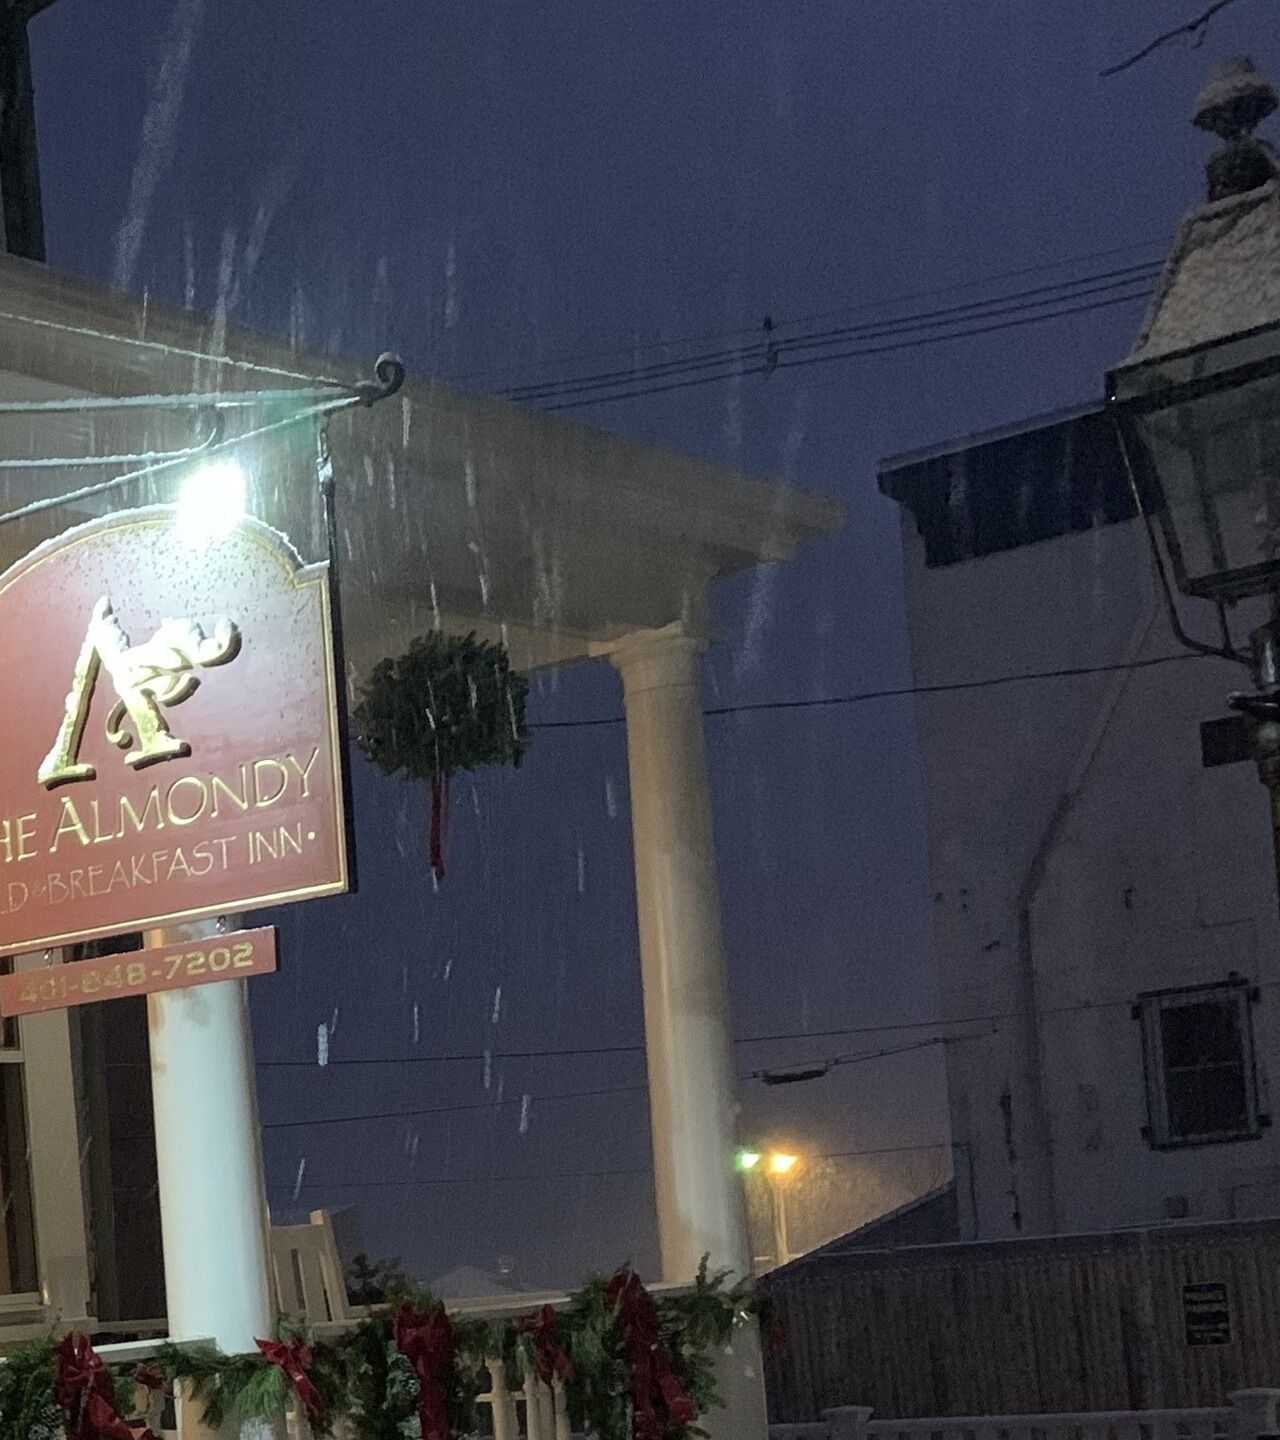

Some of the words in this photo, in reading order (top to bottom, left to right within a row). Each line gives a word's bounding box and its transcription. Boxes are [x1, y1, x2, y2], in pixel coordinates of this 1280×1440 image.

[48, 746, 320, 854] ALMONDY
[47, 835, 238, 905] BREAKFAST
[247, 821, 304, 865] INN
